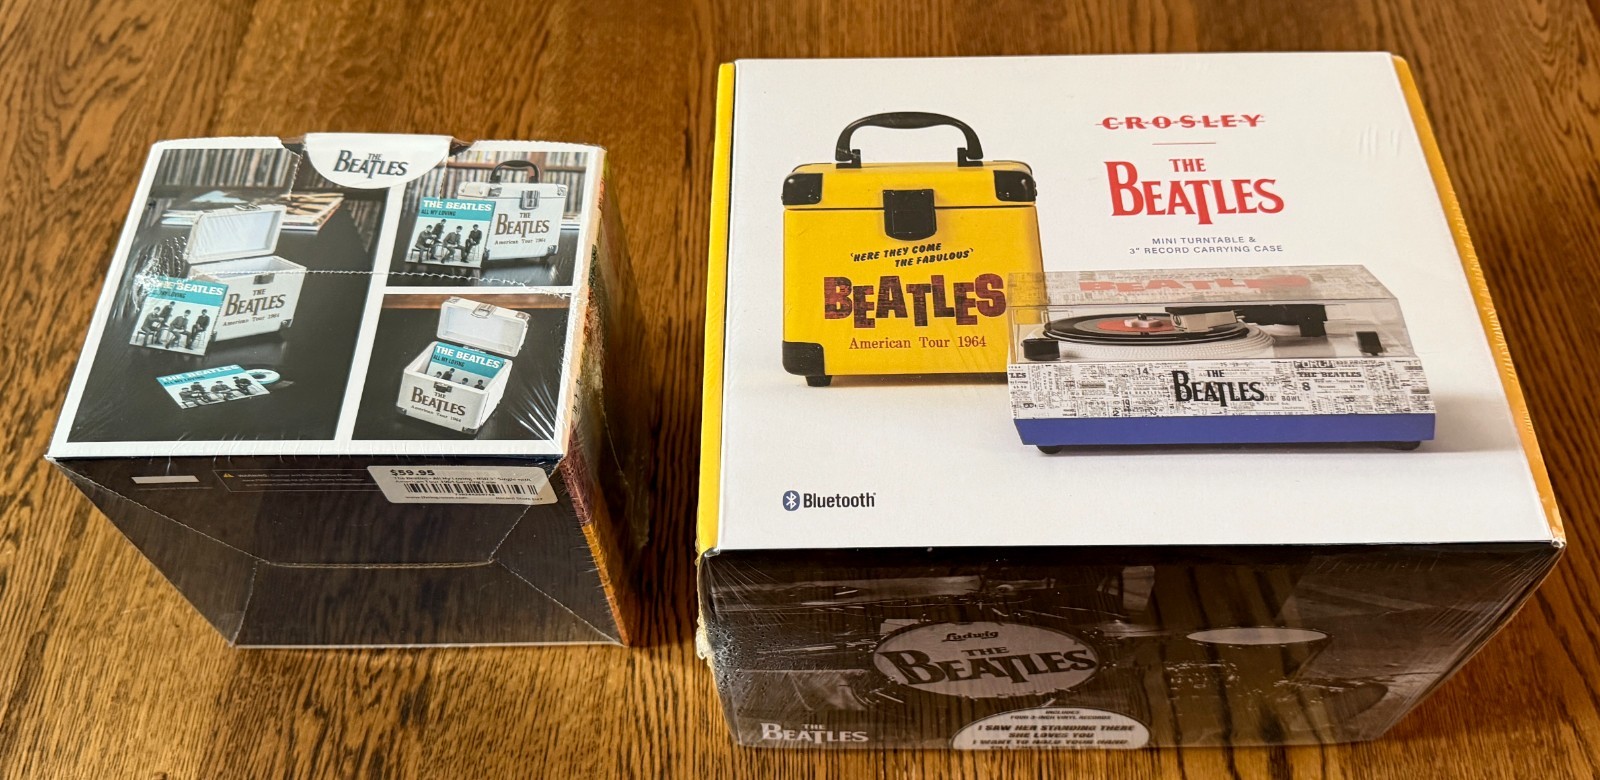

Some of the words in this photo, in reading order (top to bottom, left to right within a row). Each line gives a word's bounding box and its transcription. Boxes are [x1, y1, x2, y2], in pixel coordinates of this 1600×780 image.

[1100, 114, 1263, 130] CROSLEY
[368, 153, 382, 161] THE
[333, 150, 408, 179] BEATLES
[1168, 158, 1206, 172] THE
[1103, 161, 1284, 225] BEATLES
[423, 200, 443, 208] THE
[445, 201, 492, 212] BEATLES
[495, 213, 550, 238] BEATLES
[1182, 236, 1245, 244] TURNTABLE
[884, 247, 909, 258] THEY
[912, 243, 942, 254] COME
[1129, 247, 1140, 255] 3"
[895, 258, 913, 267] THE
[176, 282, 224, 295] BEATLES
[1079, 276, 1311, 292] BEATL
[252, 288, 266, 296] THE
[223, 293, 287, 316] BEATLES
[823, 273, 1007, 329] BEATLES
[222, 318, 249, 327] American
[849, 336, 911, 350] American
[919, 336, 950, 349] Tour
[958, 335, 987, 348] 1964
[436, 346, 454, 357] THE
[456, 351, 501, 369] BEATLES
[1136, 367, 1149, 375] 14
[1206, 370, 1225, 378] THE
[1171, 370, 1265, 407] BEATLES
[1302, 382, 1311, 391] 8
[411, 386, 466, 416] BEATLES
[390, 469, 435, 477] $59.95
[803, 492, 875, 508] Bluetooth
[941, 630, 1000, 642] Ludwig
[961, 646, 1010, 657] THE
[876, 650, 1098, 685] BEATLES
[760, 722, 870, 744] BEATLES
